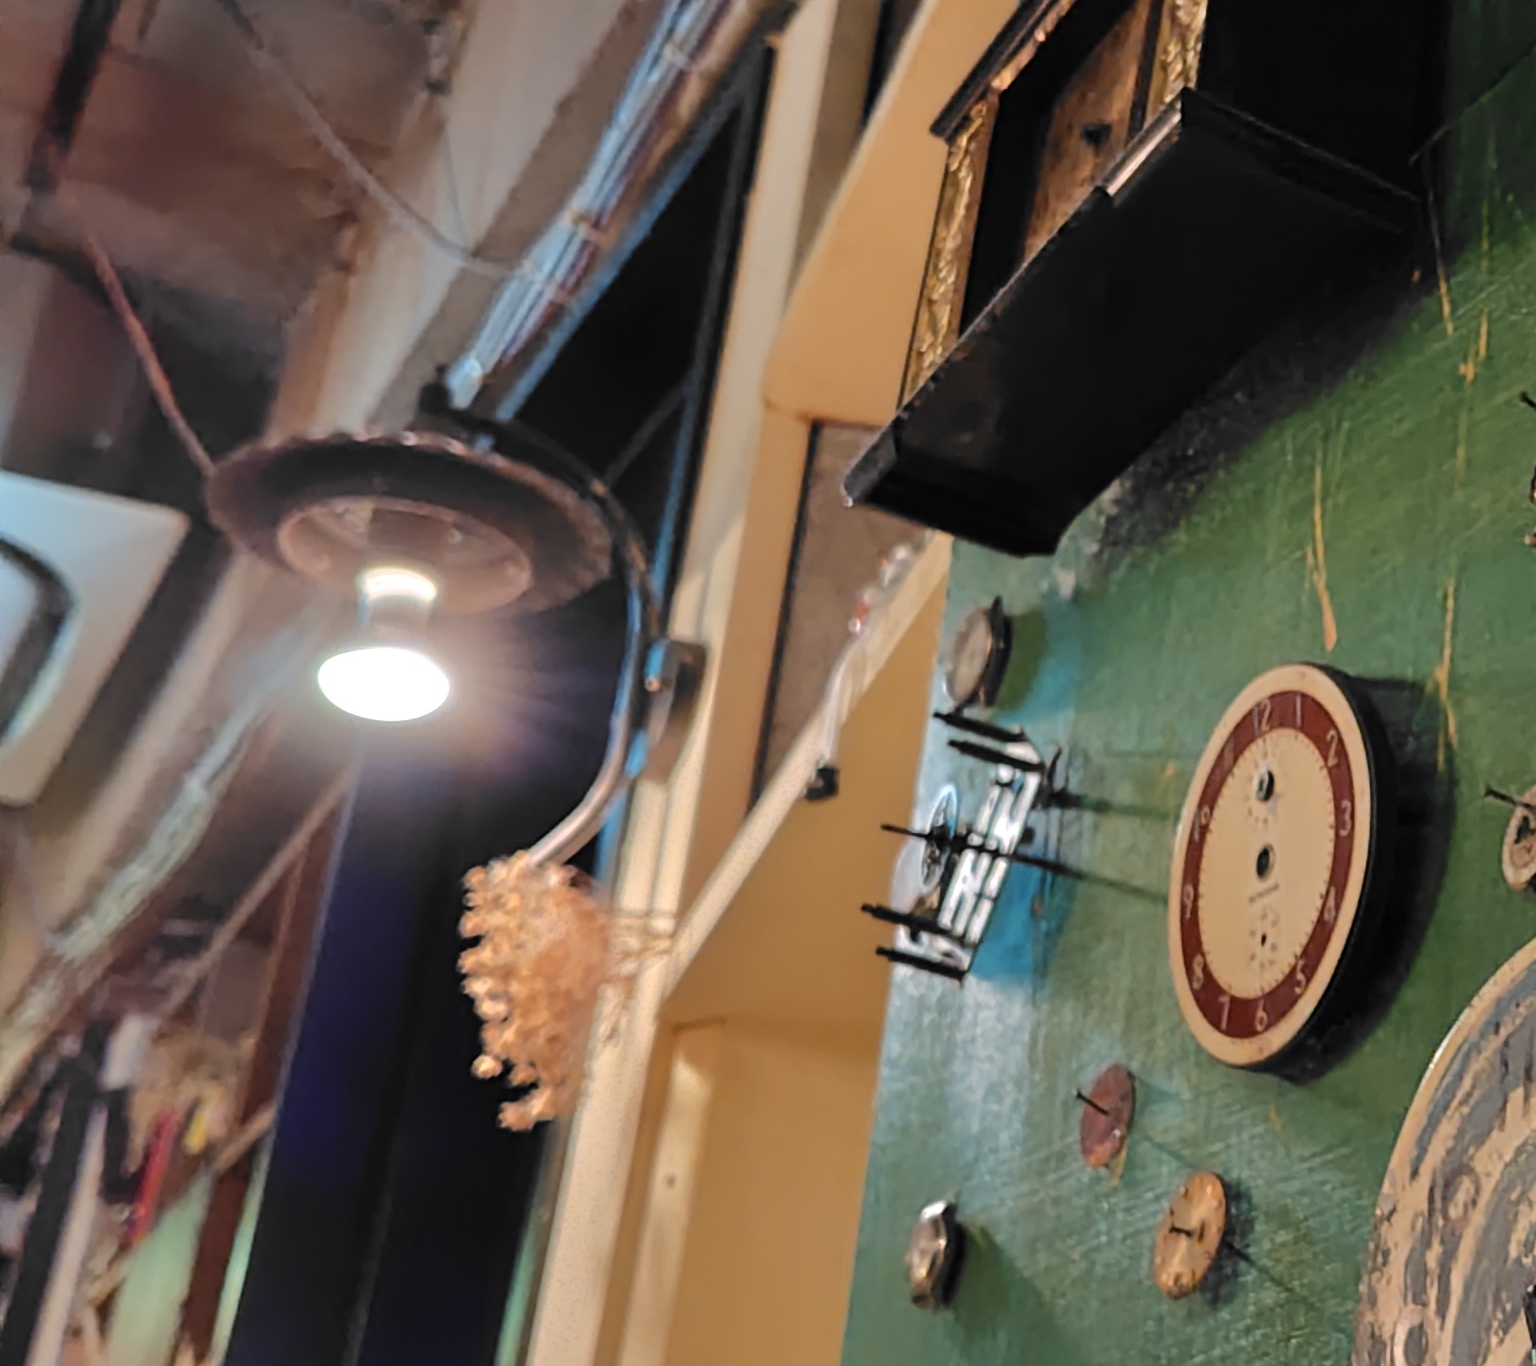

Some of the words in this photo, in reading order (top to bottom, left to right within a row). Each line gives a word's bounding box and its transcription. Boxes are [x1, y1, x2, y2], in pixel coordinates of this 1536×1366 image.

[1252, 698, 1272, 738] 12
[1326, 729, 1339, 768] 2
[1193, 804, 1211, 843] 10
[1339, 799, 1352, 836] 3
[1182, 884, 1195, 920] 9
[1323, 886, 1337, 925] 4
[1191, 953, 1205, 991] 8
[1294, 957, 1307, 995] 5
[1218, 994, 1231, 1031] 7
[1255, 998, 1269, 1033] 6
